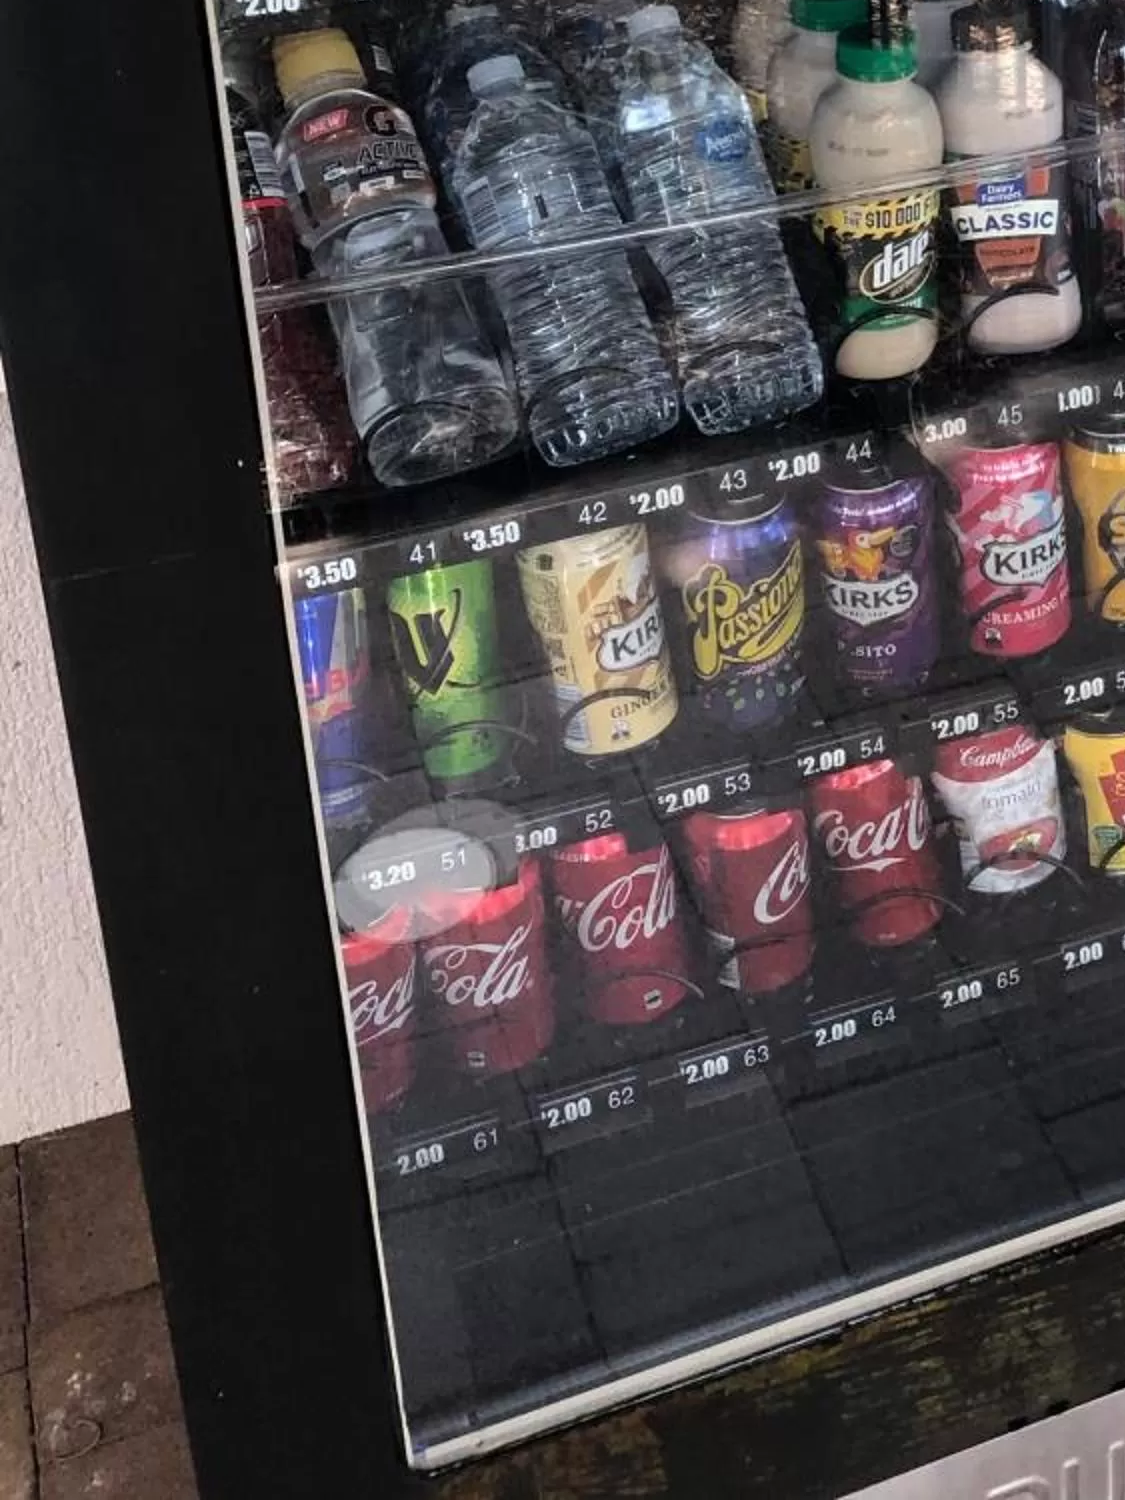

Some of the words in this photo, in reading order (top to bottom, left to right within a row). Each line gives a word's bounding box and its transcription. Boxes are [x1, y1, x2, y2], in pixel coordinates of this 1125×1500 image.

[956, 211, 1055, 235] CLASSIC
[998, 405, 1024, 428] 45
[845, 440, 873, 463] 44
[719, 470, 747, 492] 43
[578, 502, 608, 525] 42
[409, 540, 438, 564] 41
[992, 532, 1065, 576] KIRK
[1063, 677, 1105, 706] 2.00
[993, 699, 1020, 723] 55
[860, 735, 886, 759] 54
[725, 772, 752, 796] 53
[585, 809, 614, 833] 52
[441, 849, 466, 873] 51
[1063, 942, 1103, 971] 2.00
[996, 967, 1020, 989] 65
[941, 980, 982, 1009] 2.00
[871, 1006, 897, 1027] 64
[815, 1019, 857, 1048] 2.00
[744, 1047, 770, 1068] 63
[608, 1087, 634, 1109] 62
[473, 1130, 499, 1151] 61
